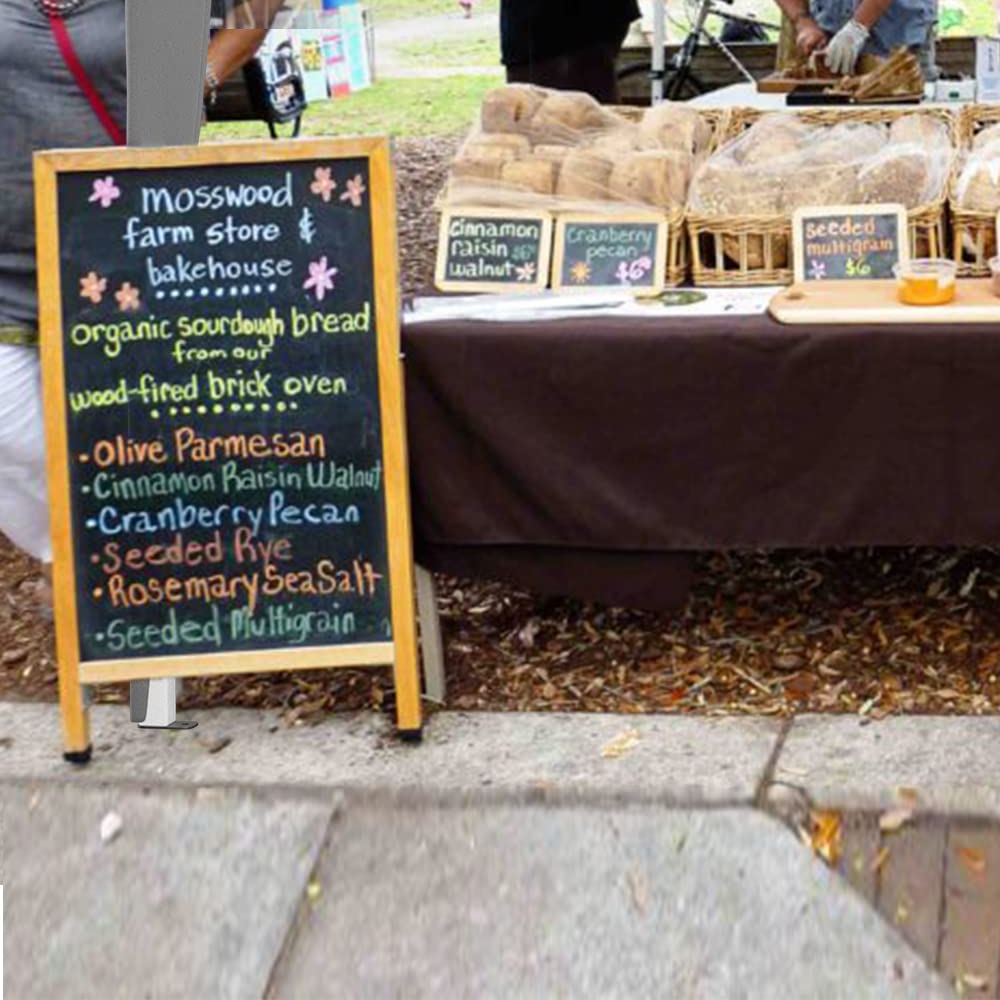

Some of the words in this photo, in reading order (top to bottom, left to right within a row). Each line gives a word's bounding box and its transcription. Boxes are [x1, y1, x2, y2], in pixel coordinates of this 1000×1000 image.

[123, 217, 194, 250] farm
[206, 217, 280, 246] store
[299, 208, 317, 243] &
[451, 238, 507, 257] raisin
[807, 238, 893, 258] multigrain
[147, 255, 293, 287] bakehouse
[450, 258, 514, 277] walnut
[586, 245, 638, 262] pecan
[845, 257, 871, 276] $6
[71, 310, 172, 357] organic
[178, 308, 285, 346] sourdough
[292, 302, 370, 335] bread
[172, 343, 228, 363] from
[233, 345, 273, 361] our
[70, 375, 199, 412] wood-fired
[209, 369, 271, 399] brick
[283, 374, 347, 395] oven
[94, 436, 168, 467] Olive
[175, 427, 325, 462] Parmesan
[93, 471, 215, 500] Cinnamon
[222, 460, 301, 491] Raisin
[306, 459, 382, 489] Walnut
[100, 499, 262, 536] Cranberry
[269, 490, 360, 526] Pecan
[102, 531, 224, 575] Seeded
[233, 526, 293, 566] Rye
[108, 571, 259, 616] Rosemary
[106, 606, 222, 651] Seeded
[230, 602, 355, 645] Multigrain
